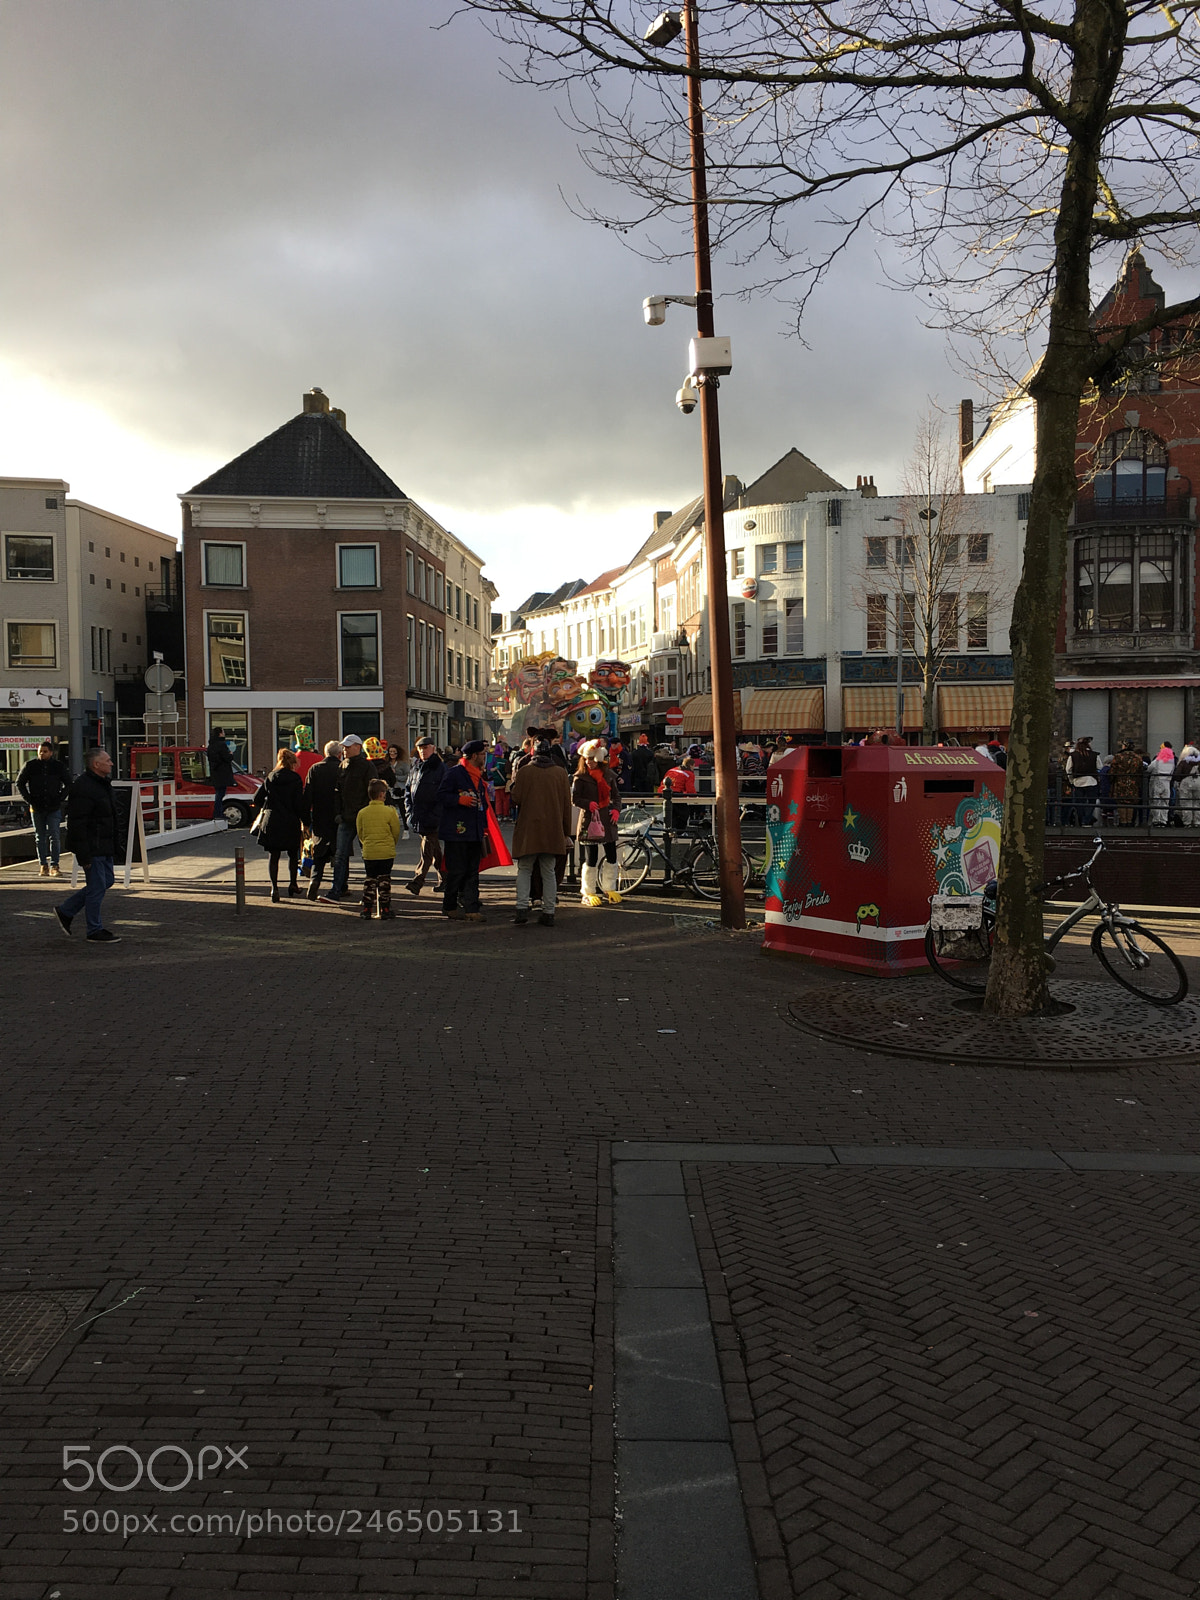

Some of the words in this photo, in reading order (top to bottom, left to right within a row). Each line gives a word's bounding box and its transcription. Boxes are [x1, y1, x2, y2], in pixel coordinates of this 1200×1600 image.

[904, 753, 979, 765] Afvalbak
[782, 898, 803, 922] Enjoy
[804, 890, 831, 909] Breda
